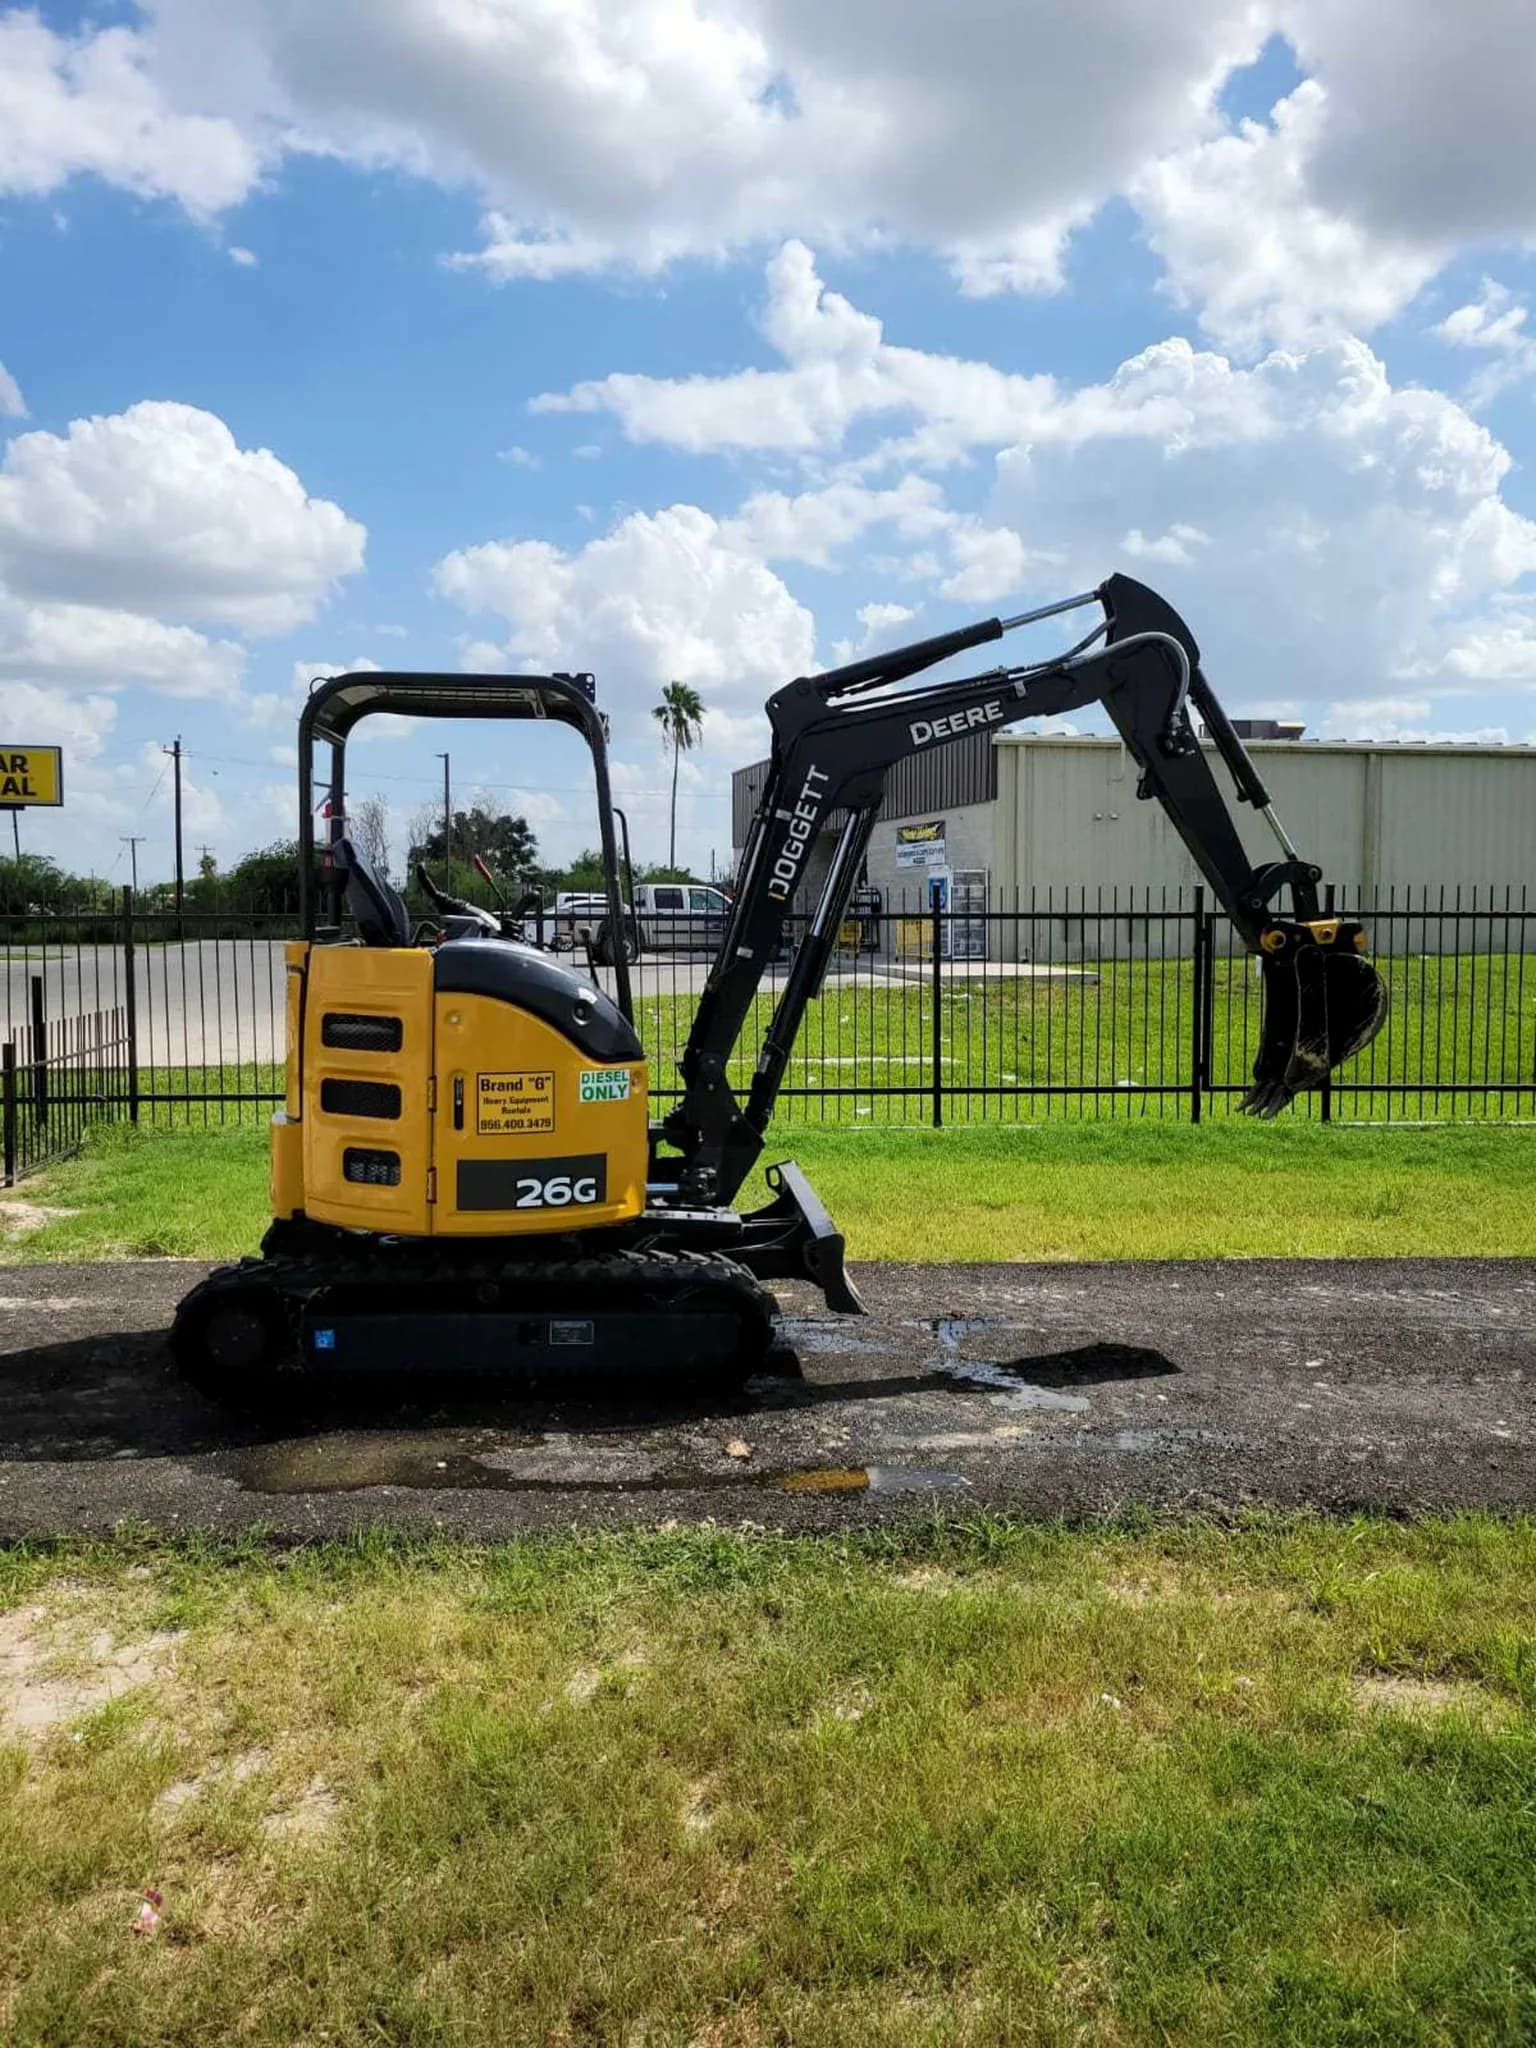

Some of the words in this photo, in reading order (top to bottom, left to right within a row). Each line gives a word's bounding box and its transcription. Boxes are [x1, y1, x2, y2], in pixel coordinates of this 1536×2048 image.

[909, 701, 1004, 745] DEERE
[768, 764, 829, 901] DOGGETT
[480, 1077, 523, 1092] Brand
[581, 1071, 628, 1084] DIESEL
[582, 1084, 627, 1100] ONLY
[516, 1177, 596, 1207] 26G
